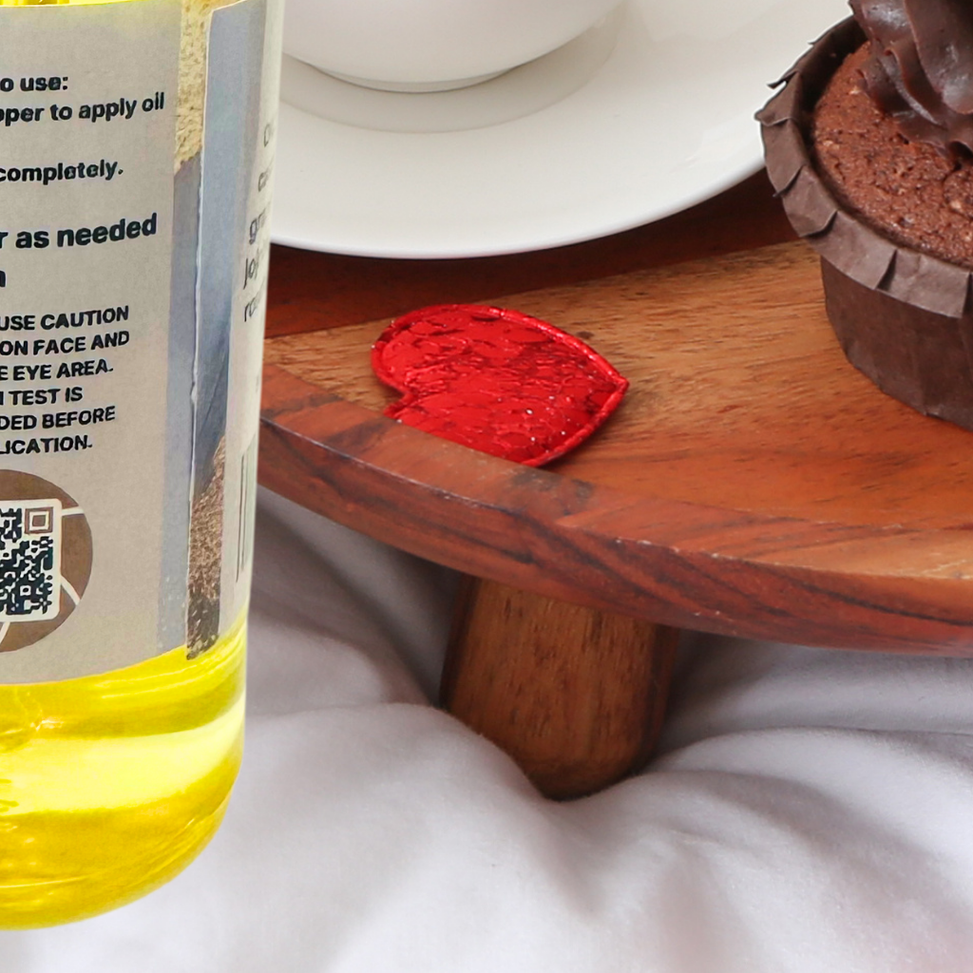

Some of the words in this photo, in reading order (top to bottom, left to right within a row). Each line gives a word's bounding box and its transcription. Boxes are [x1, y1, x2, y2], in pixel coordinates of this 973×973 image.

[19, 75, 69, 93] use:
[49, 103, 73, 122] to
[78, 97, 138, 124] apply
[141, 91, 165, 113] oil
[15, 230, 50, 250] as
[56, 211, 158, 248] needed
[39, 304, 130, 331] CAUTION
[32, 335, 87, 356] FACE
[90, 330, 130, 351] AND
[12, 364, 53, 382] EYE
[55, 358, 114, 379] AREA.
[7, 388, 62, 406] TEST
[64, 386, 84, 403] IS
[41, 405, 116, 430] BEFORE
